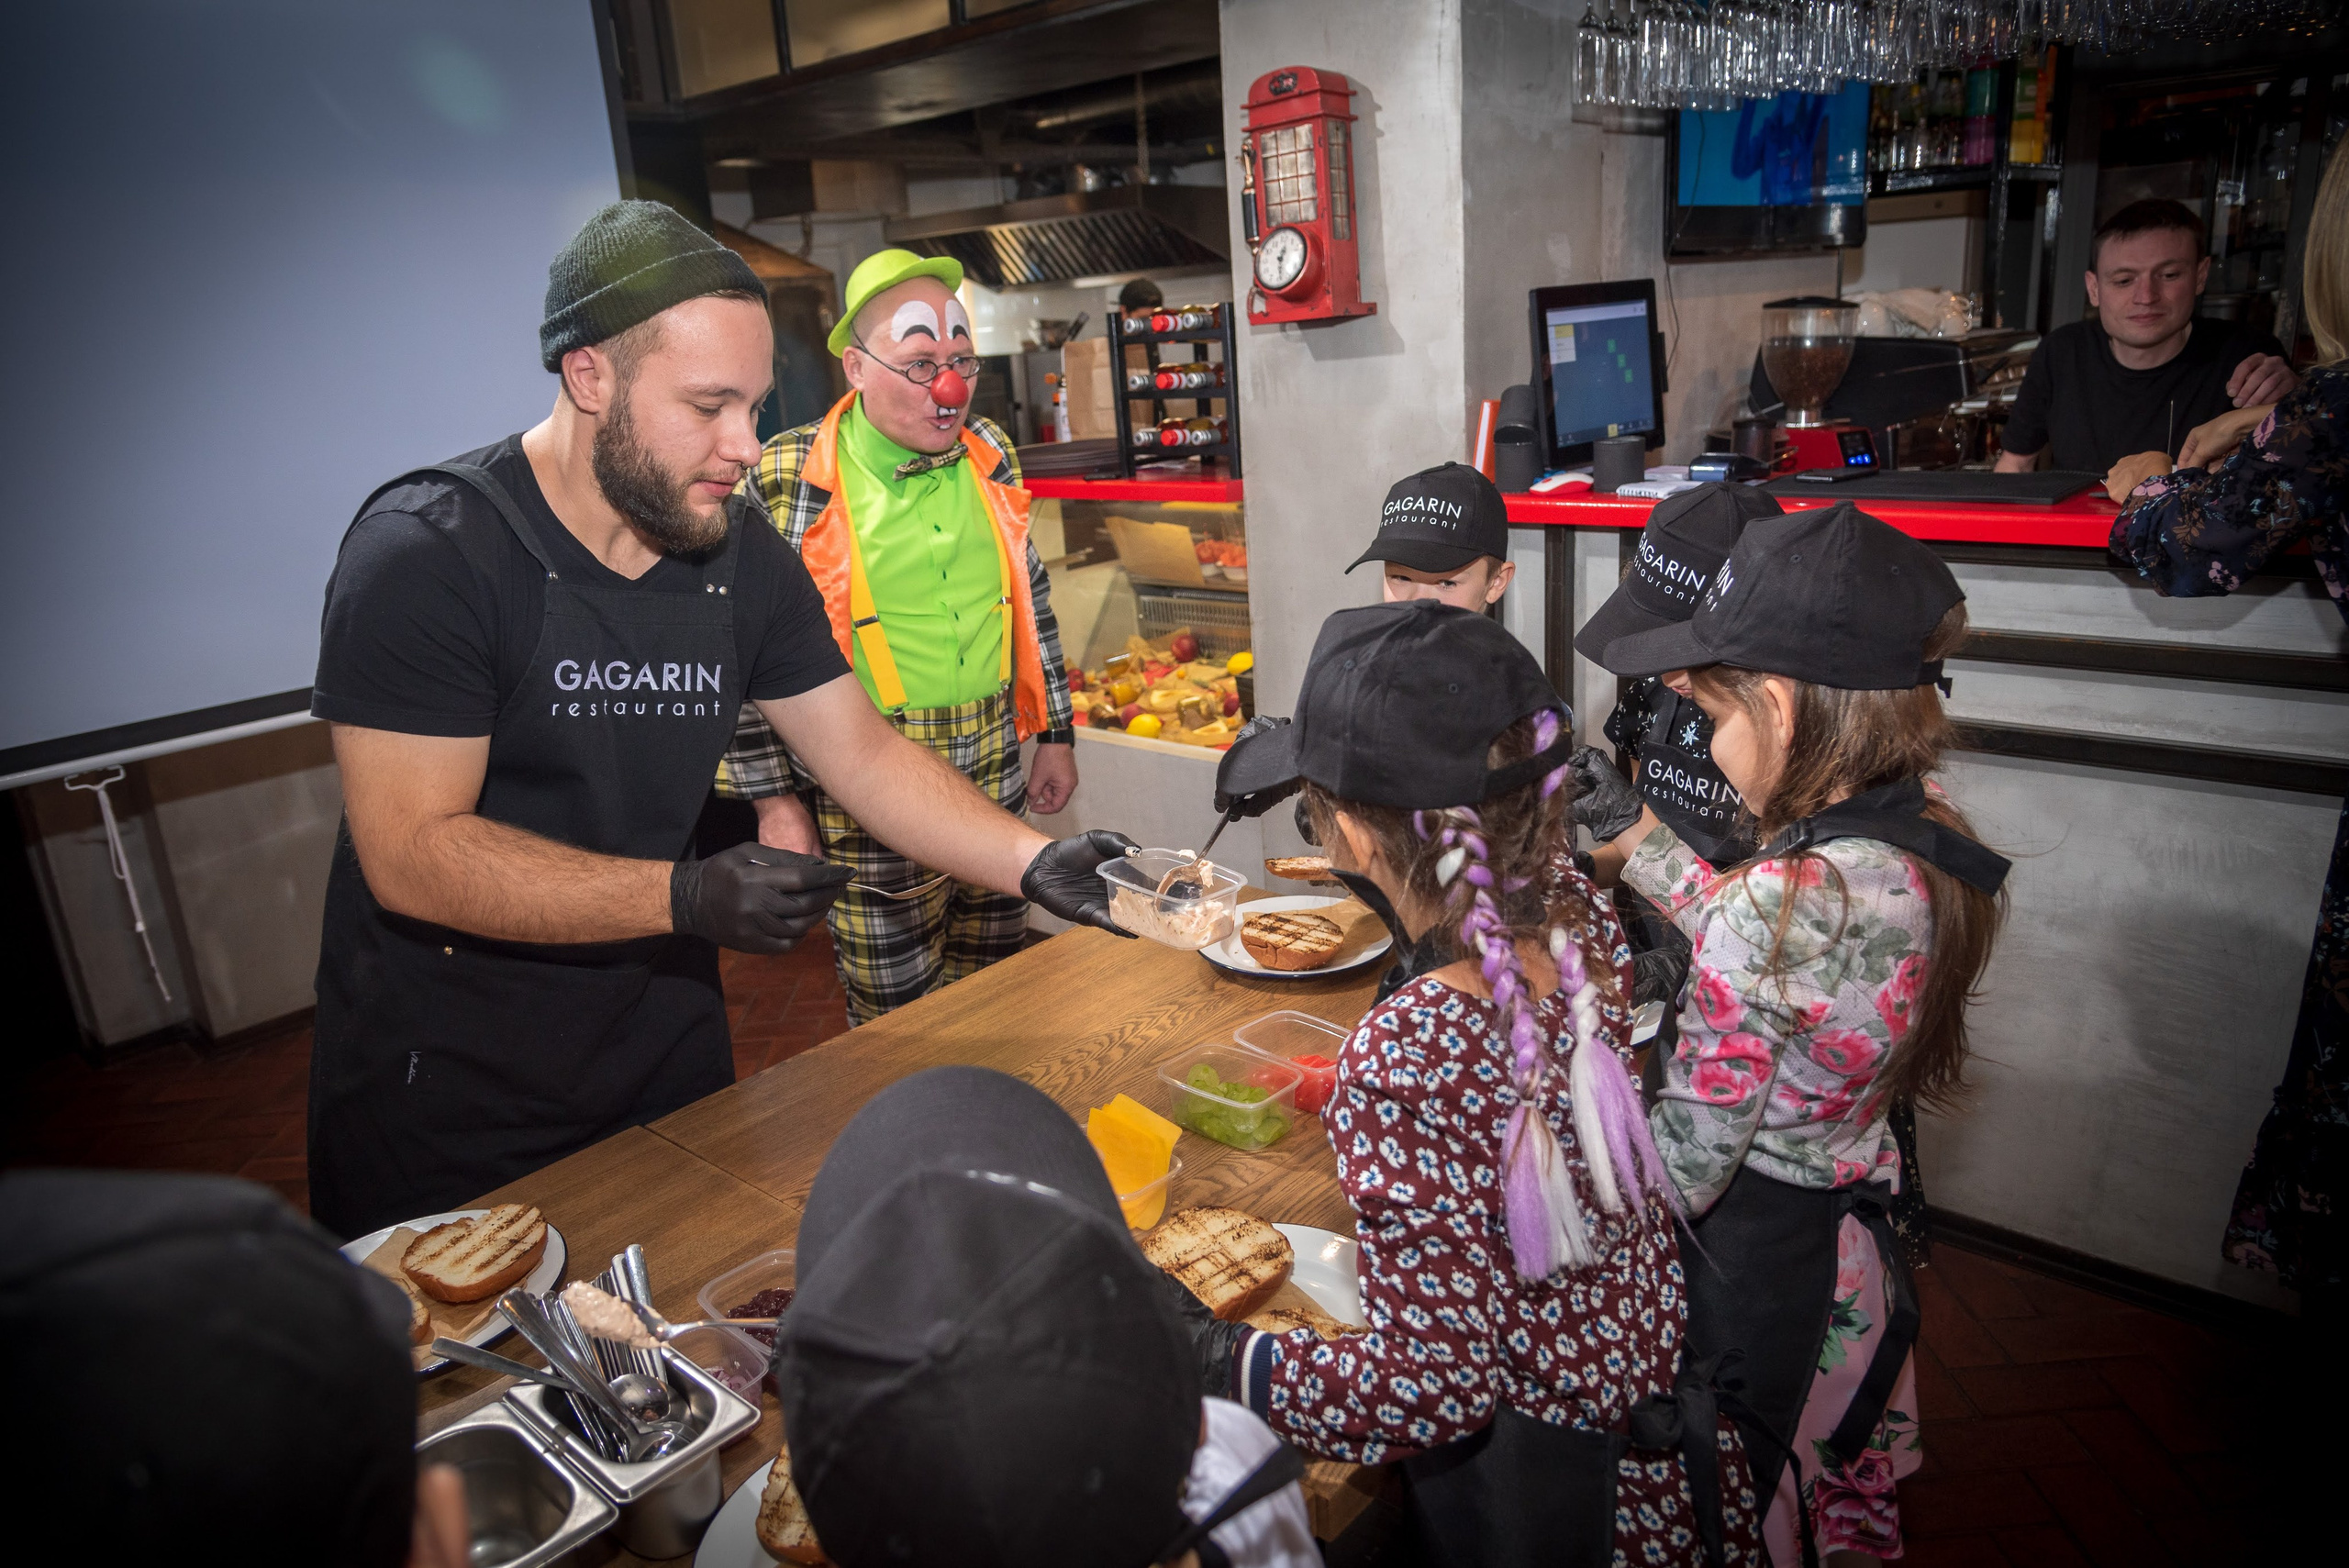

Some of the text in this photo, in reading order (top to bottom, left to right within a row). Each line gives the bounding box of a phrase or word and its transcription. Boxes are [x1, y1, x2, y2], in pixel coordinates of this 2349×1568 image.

[1384, 496, 1463, 519] GAGARIN
[1639, 531, 1707, 592] GAGARIN
[554, 659, 722, 694] GAGARIN
[551, 698, 721, 717] restaurant
[1648, 759, 1742, 806] GAGARIN
[1643, 784, 1738, 822] restaurant
